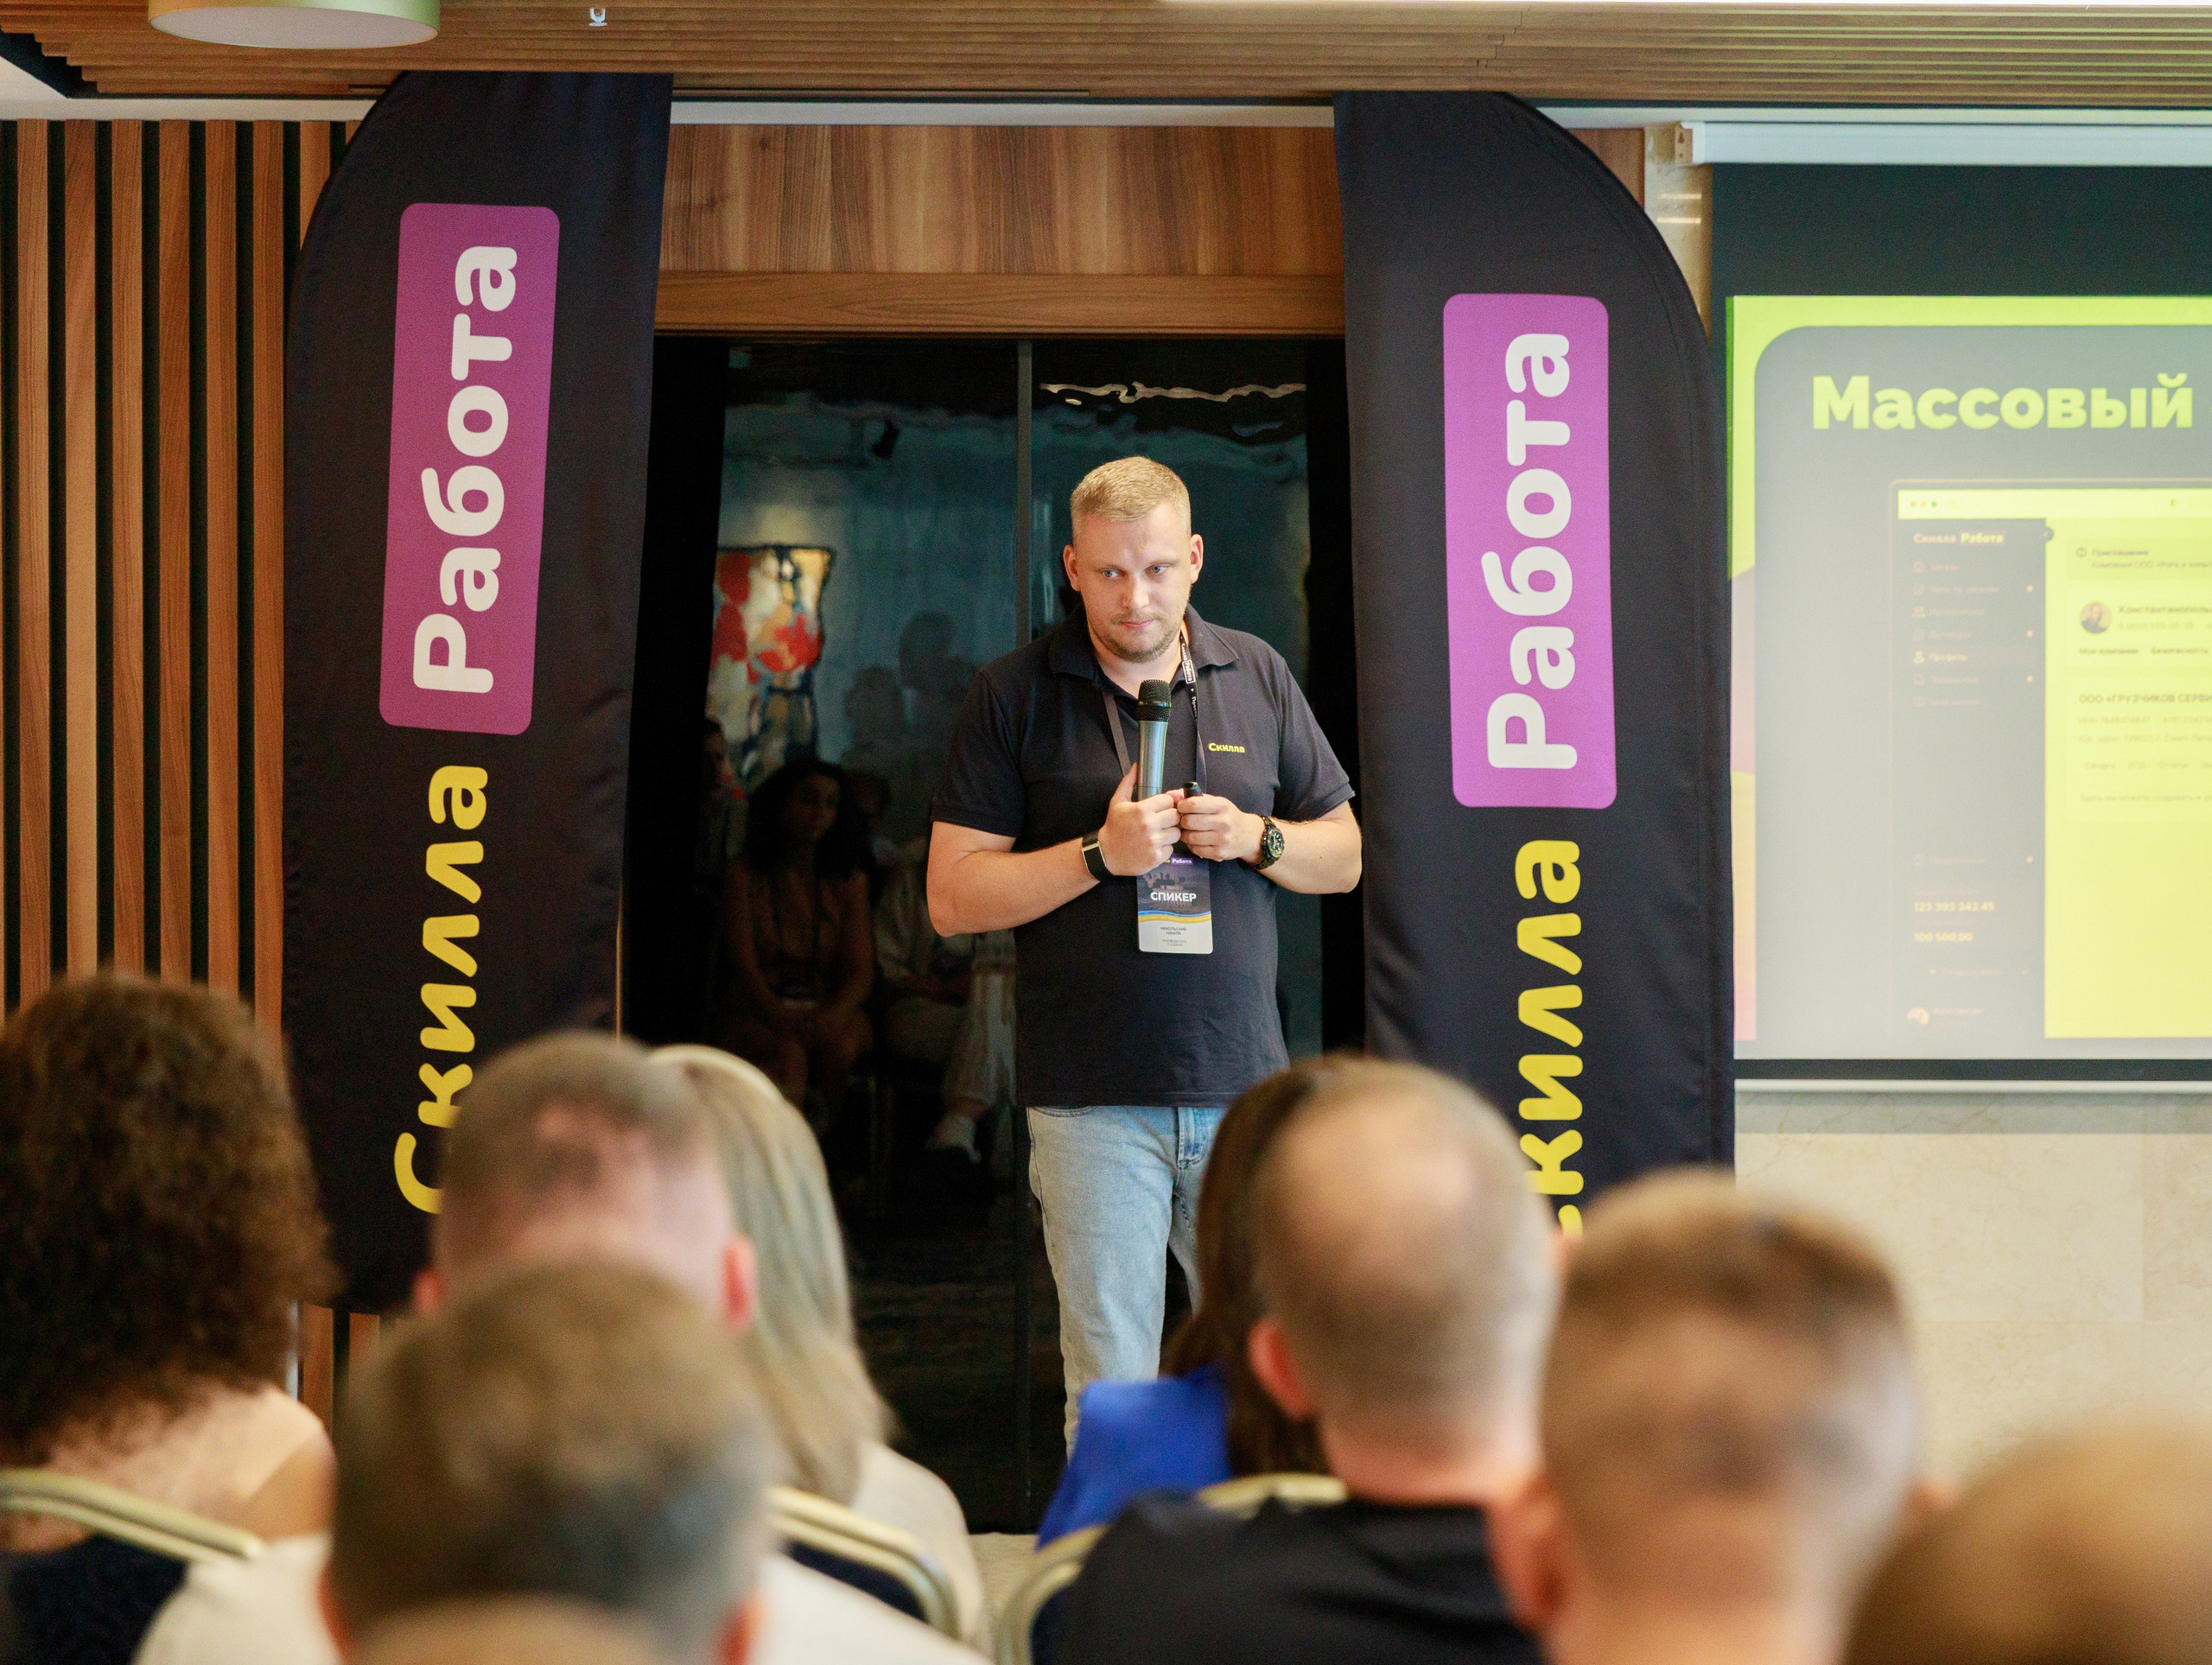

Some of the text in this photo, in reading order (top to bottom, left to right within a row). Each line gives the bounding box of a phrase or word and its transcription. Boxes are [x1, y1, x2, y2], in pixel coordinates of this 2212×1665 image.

[1813, 372, 2193, 429] Массовый
[1912, 531, 2005, 544] Скилла Работа
[1184, 662, 1192, 682] Работа
[2078, 694, 2104, 703] ООО
[394, 245, 518, 1214] Скилла Работа
[1208, 742, 1246, 753] Скилла
[1480, 333, 1584, 1239] килла Работа
[1150, 892, 1197, 902] СПИКЕР
